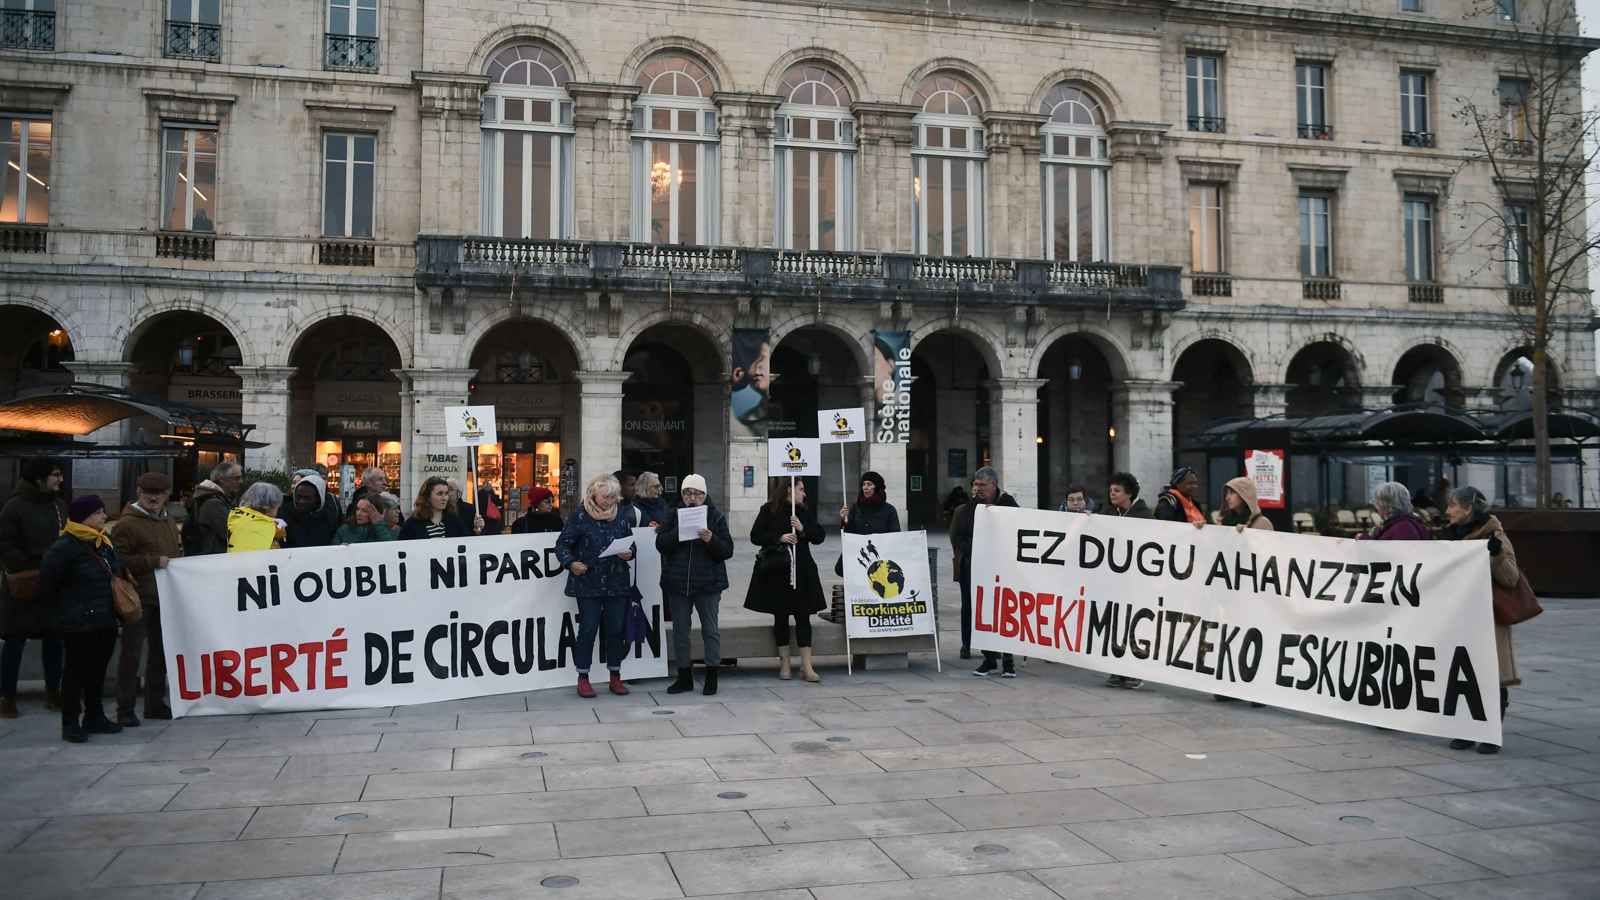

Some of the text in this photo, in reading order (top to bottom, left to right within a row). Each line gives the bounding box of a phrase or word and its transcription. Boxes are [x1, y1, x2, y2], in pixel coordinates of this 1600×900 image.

[187, 389, 240, 400] BRASSERI
[895, 347, 911, 443] nationale
[877, 379, 895, 443] Scène
[341, 420, 380, 430] TABAC
[426, 454, 458, 463] TABAC
[424, 465, 458, 473] CADEAUX
[479, 547, 564, 585] PARD
[1016, 528, 1422, 607] EZ DUGU AHANZTEN
[853, 602, 926, 616] Etorkinekin
[870, 614, 912, 627] Diakité
[176, 627, 348, 701] LIBERTÉ
[364, 629, 414, 686] DE
